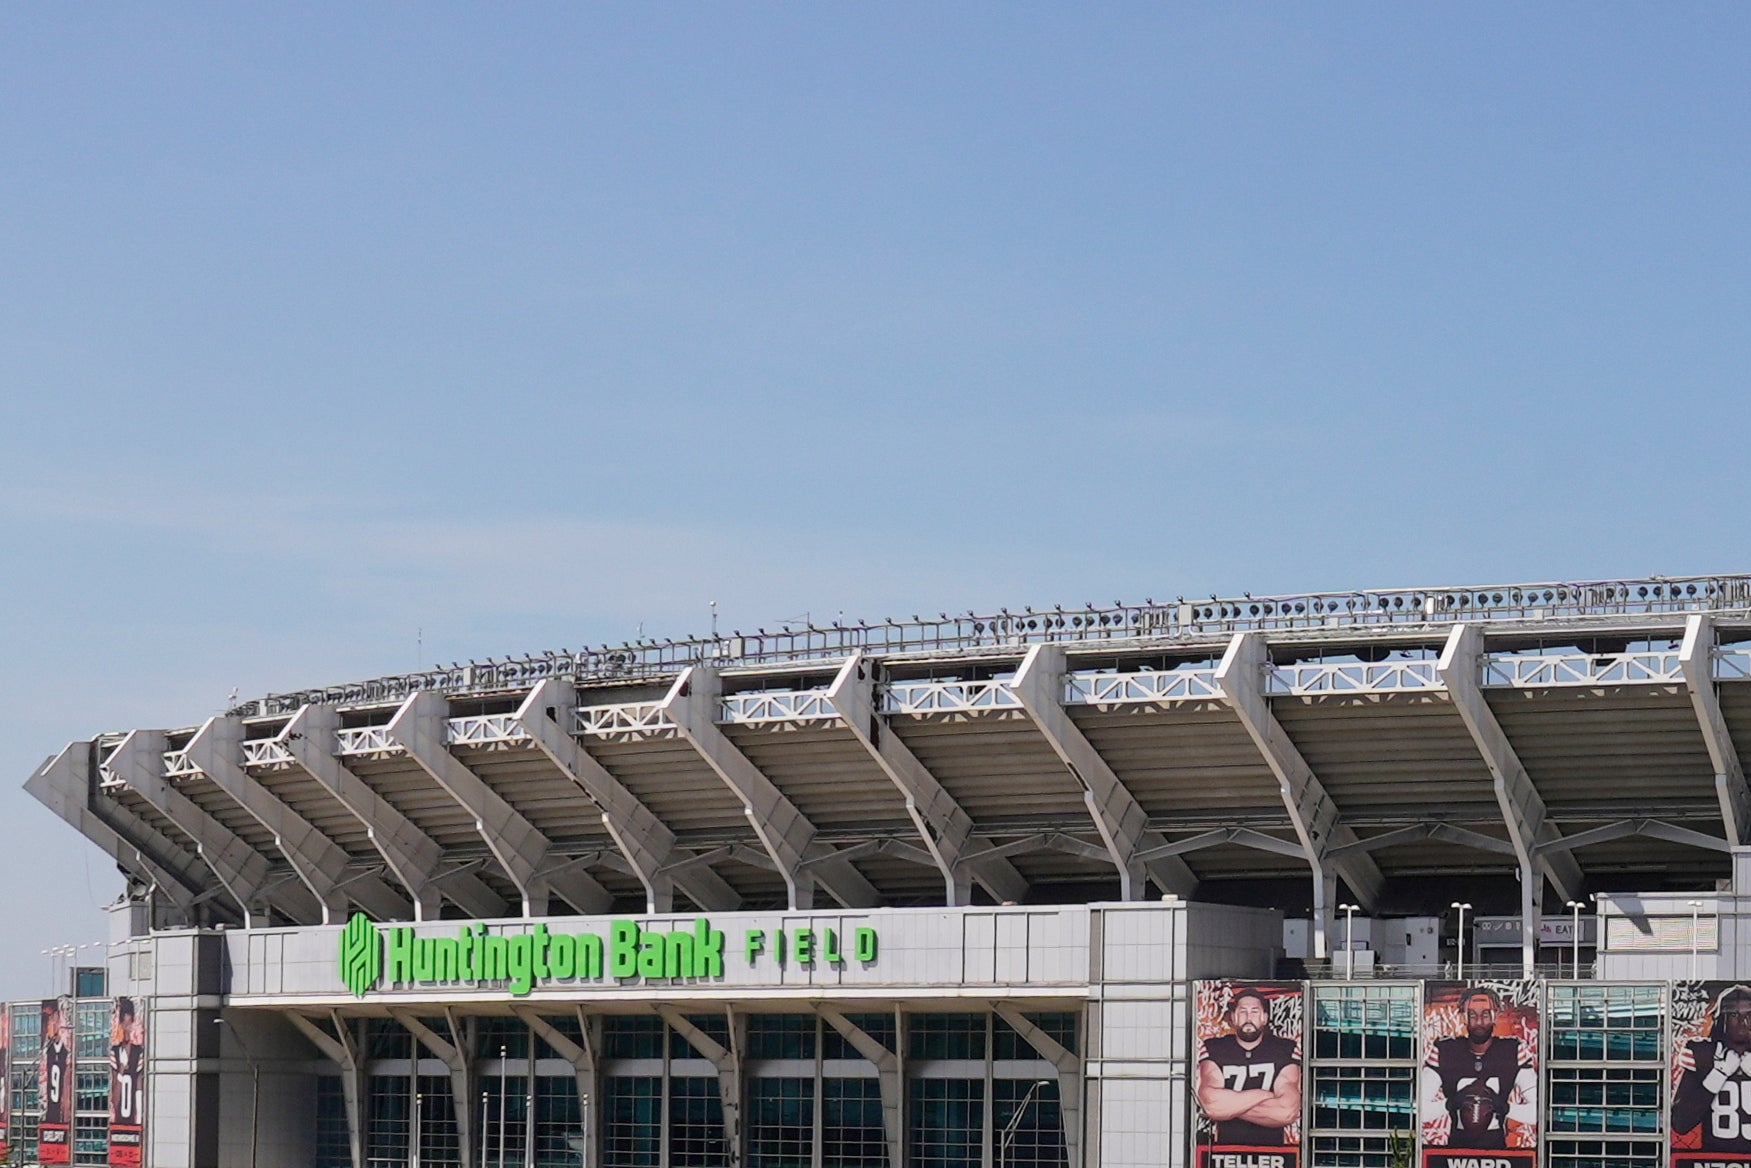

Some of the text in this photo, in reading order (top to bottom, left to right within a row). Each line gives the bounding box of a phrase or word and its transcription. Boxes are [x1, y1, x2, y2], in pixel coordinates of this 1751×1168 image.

[389, 917, 877, 996] Huntington Bank FIELD
